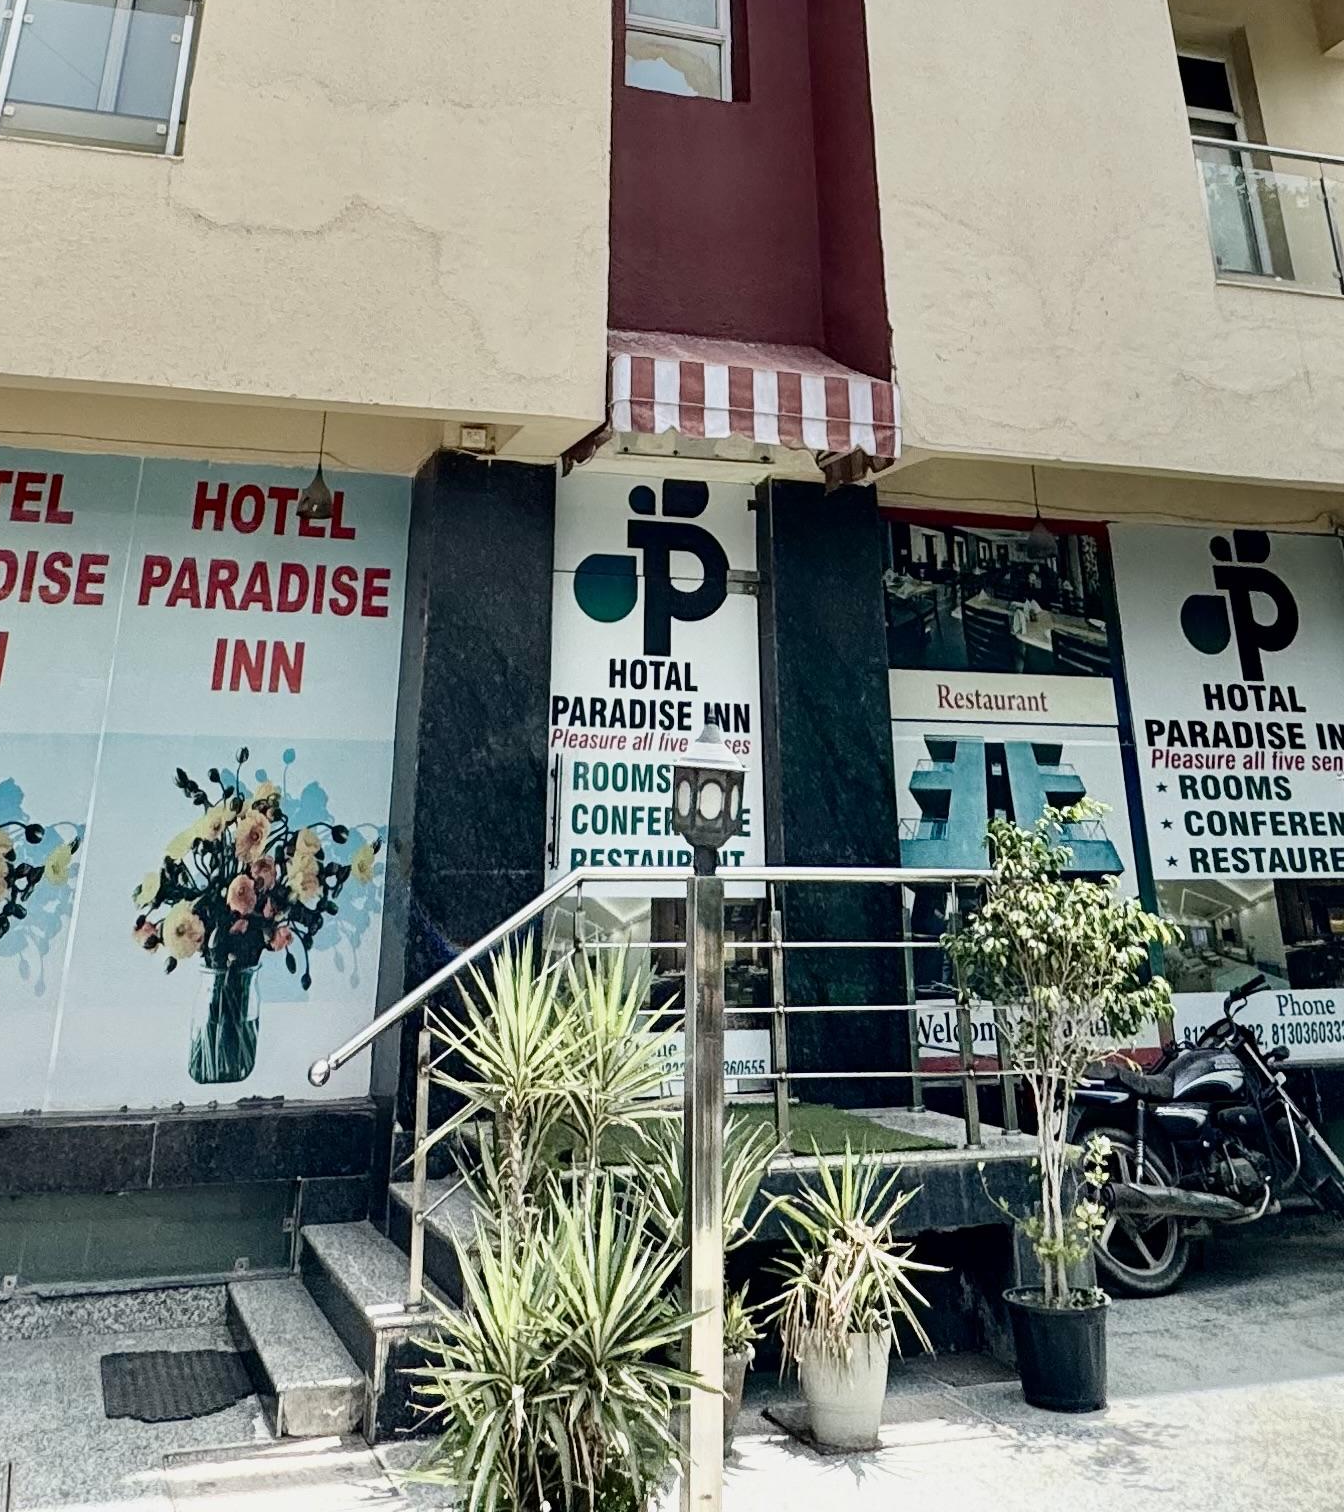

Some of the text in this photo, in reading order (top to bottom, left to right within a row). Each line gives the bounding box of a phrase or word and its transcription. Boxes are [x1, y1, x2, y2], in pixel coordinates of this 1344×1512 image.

[137, 555, 391, 618] PARADISE
[211, 638, 306, 694] INN
[609, 658, 698, 692] HOTAL
[936, 683, 1049, 712] Restaurant
[1203, 683, 1306, 713] HOTAL
[551, 695, 751, 733] PARADISE INN
[551, 728, 627, 751] Pleasure
[632, 732, 654, 751] all
[724, 738, 751, 754] ses
[1144, 719, 1307, 750] PARADISE
[1151, 749, 1236, 770] Pleasure
[1243, 751, 1264, 770] all
[1272, 751, 1305, 771] five
[572, 761, 671, 793] ROOMS
[1178, 774, 1292, 801] ROOMS
[571, 803, 751, 837] CONFERE
[1276, 993, 1336, 1016] Phone
